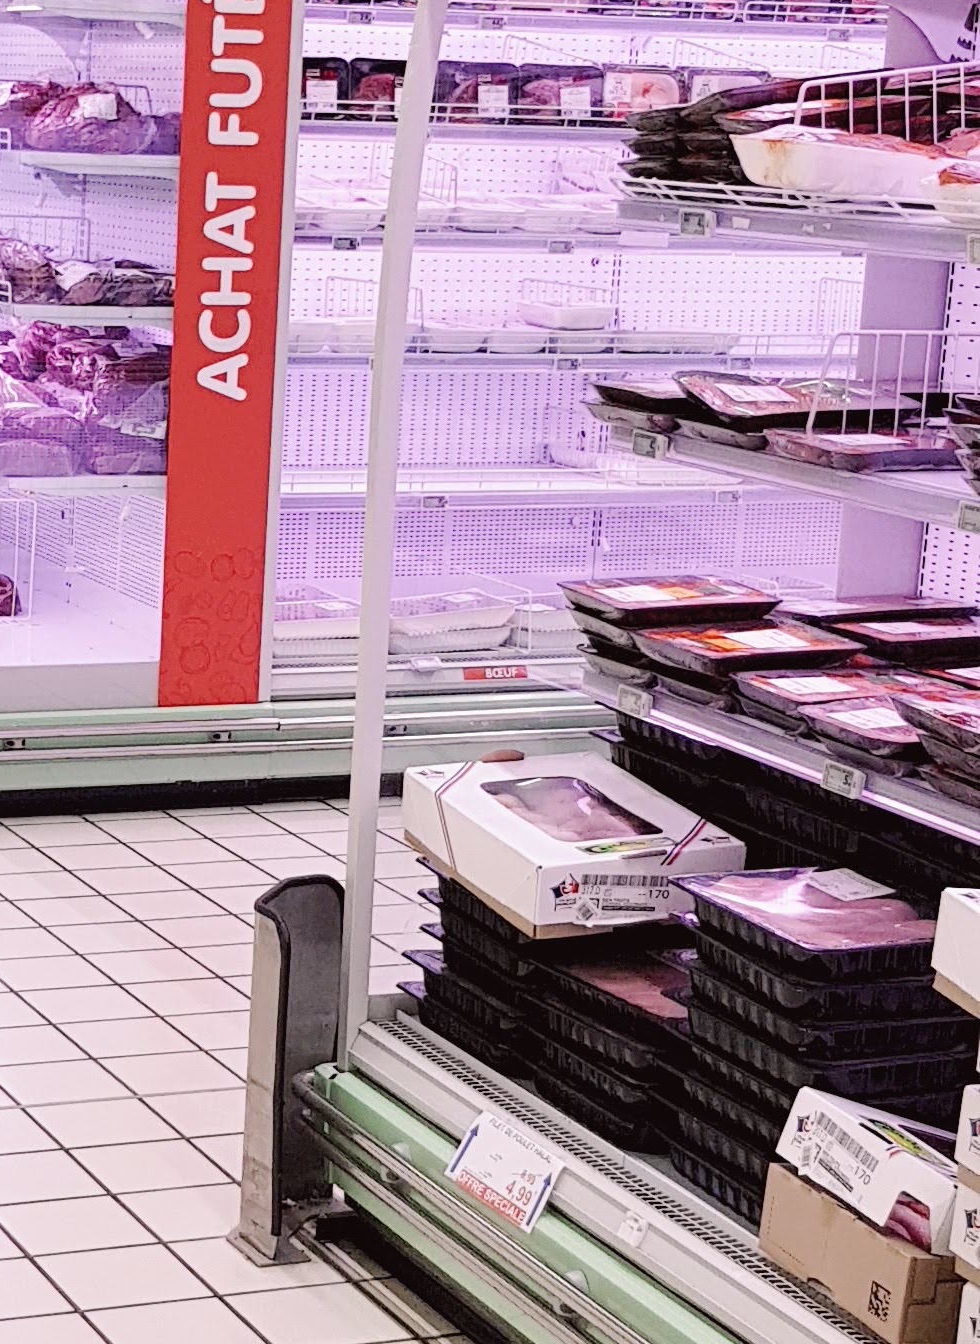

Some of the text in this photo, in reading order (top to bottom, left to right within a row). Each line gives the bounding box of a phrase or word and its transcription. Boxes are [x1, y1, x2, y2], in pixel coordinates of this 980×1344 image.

[197, 171, 257, 402] ACHAT
[485, 667, 518, 678] BŒUF
[457, 1171, 485, 1196] OFFRE
[483, 1188, 527, 1222] SPECIALE
[506, 1180, 532, 1206] 4,99
